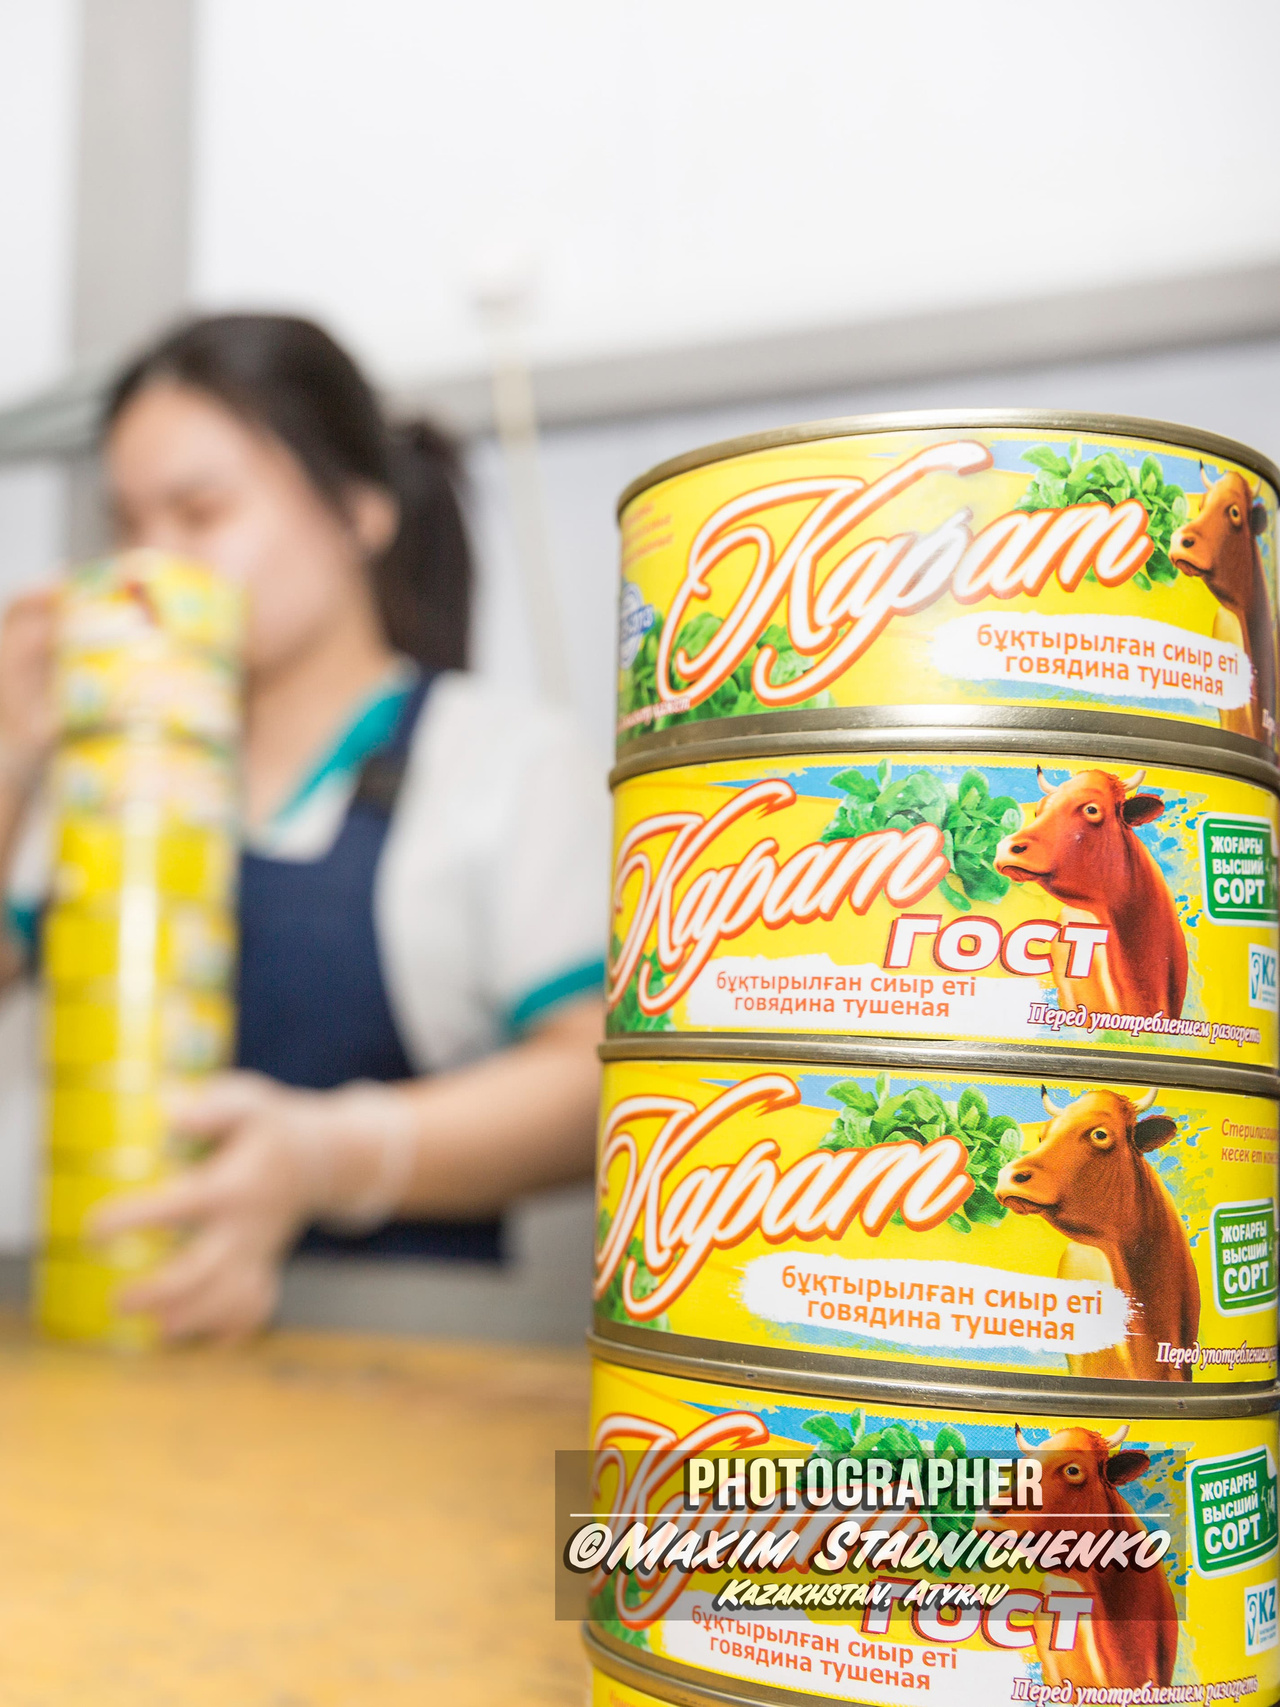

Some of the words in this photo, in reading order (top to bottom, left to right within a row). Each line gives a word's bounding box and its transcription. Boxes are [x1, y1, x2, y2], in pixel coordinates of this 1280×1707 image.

[657, 439, 1154, 706] Карат
[977, 624, 1155, 658] бұқтырылған
[1162, 643, 1213, 671] сиыр
[1218, 652, 1239, 675] еті
[1005, 655, 1130, 680] говядина
[1137, 664, 1224, 696] тушеная
[1212, 856, 1265, 875] ВЫСШИЙ
[610, 778, 950, 1016] Карат
[1213, 878, 1266, 905] СОРТ
[886, 913, 1109, 980] ГОСТ
[716, 971, 862, 994] бұқтырылған
[870, 977, 934, 998] сиыр
[942, 976, 976, 996] еті
[1262, 954, 1276, 988] KZ
[735, 995, 835, 1014] говядина
[843, 998, 950, 1018] тушеная
[1027, 1002, 1087, 1031] Перед
[1087, 1011, 1210, 1037] употреблением
[1210, 1023, 1261, 1047] разогреть
[1221, 1147, 1250, 1163] кесек
[595, 1073, 975, 1322] Карат
[1222, 1239, 1268, 1265] ВЫСШИЙ
[782, 1266, 974, 1304] бұқтырылған
[984, 1288, 1058, 1316] сиыр
[1066, 1291, 1102, 1314] еті
[1223, 1262, 1269, 1295] СОРТ
[807, 1300, 941, 1330] говядина
[951, 1313, 1075, 1340] тушеная
[1155, 1341, 1201, 1370] Перед
[1202, 1490, 1259, 1525] ВЫСШИЙ
[1204, 1512, 1261, 1556] СОРТ
[1259, 1586, 1276, 1625] KZ
[692, 1605, 839, 1653] бұқтырылған
[847, 1640, 914, 1668] сиыр
[921, 1647, 957, 1669] еті
[710, 1635, 812, 1673] говядина
[820, 1657, 931, 1691] тушеная
[1011, 1678, 1072, 1707] Перед
[1071, 1680, 1204, 1707] употреблением
[1204, 1675, 1259, 1706] разогреть
